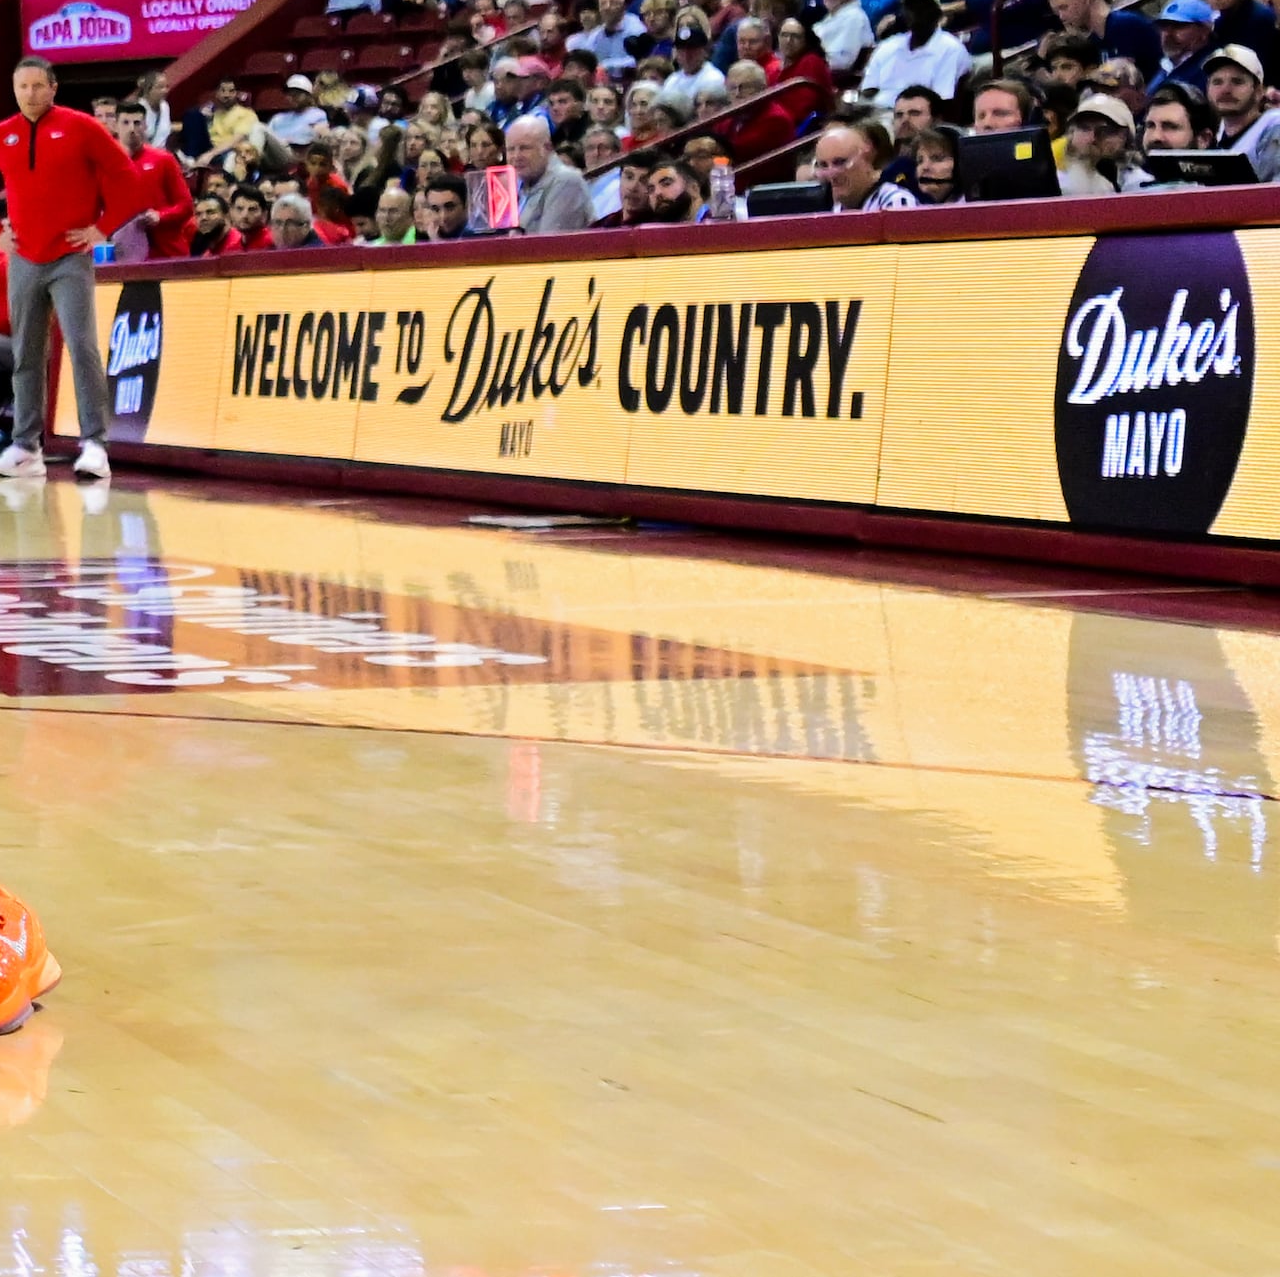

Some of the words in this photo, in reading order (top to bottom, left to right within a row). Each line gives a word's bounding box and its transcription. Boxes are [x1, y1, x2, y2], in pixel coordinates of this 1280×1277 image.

[36, 20, 72, 45] PAPA
[148, 18, 196, 34] LOCALLY
[198, 14, 233, 30] OPER
[108, 312, 160, 376] Duke's
[232, 312, 386, 401] WELCOME
[395, 311, 426, 374] TO
[441, 276, 603, 424] Duke's
[618, 300, 863, 420] COUNTRY.
[1067, 288, 1241, 405] Duke's
[498, 420, 535, 459] MAYO
[1102, 409, 1186, 479] MAYO
